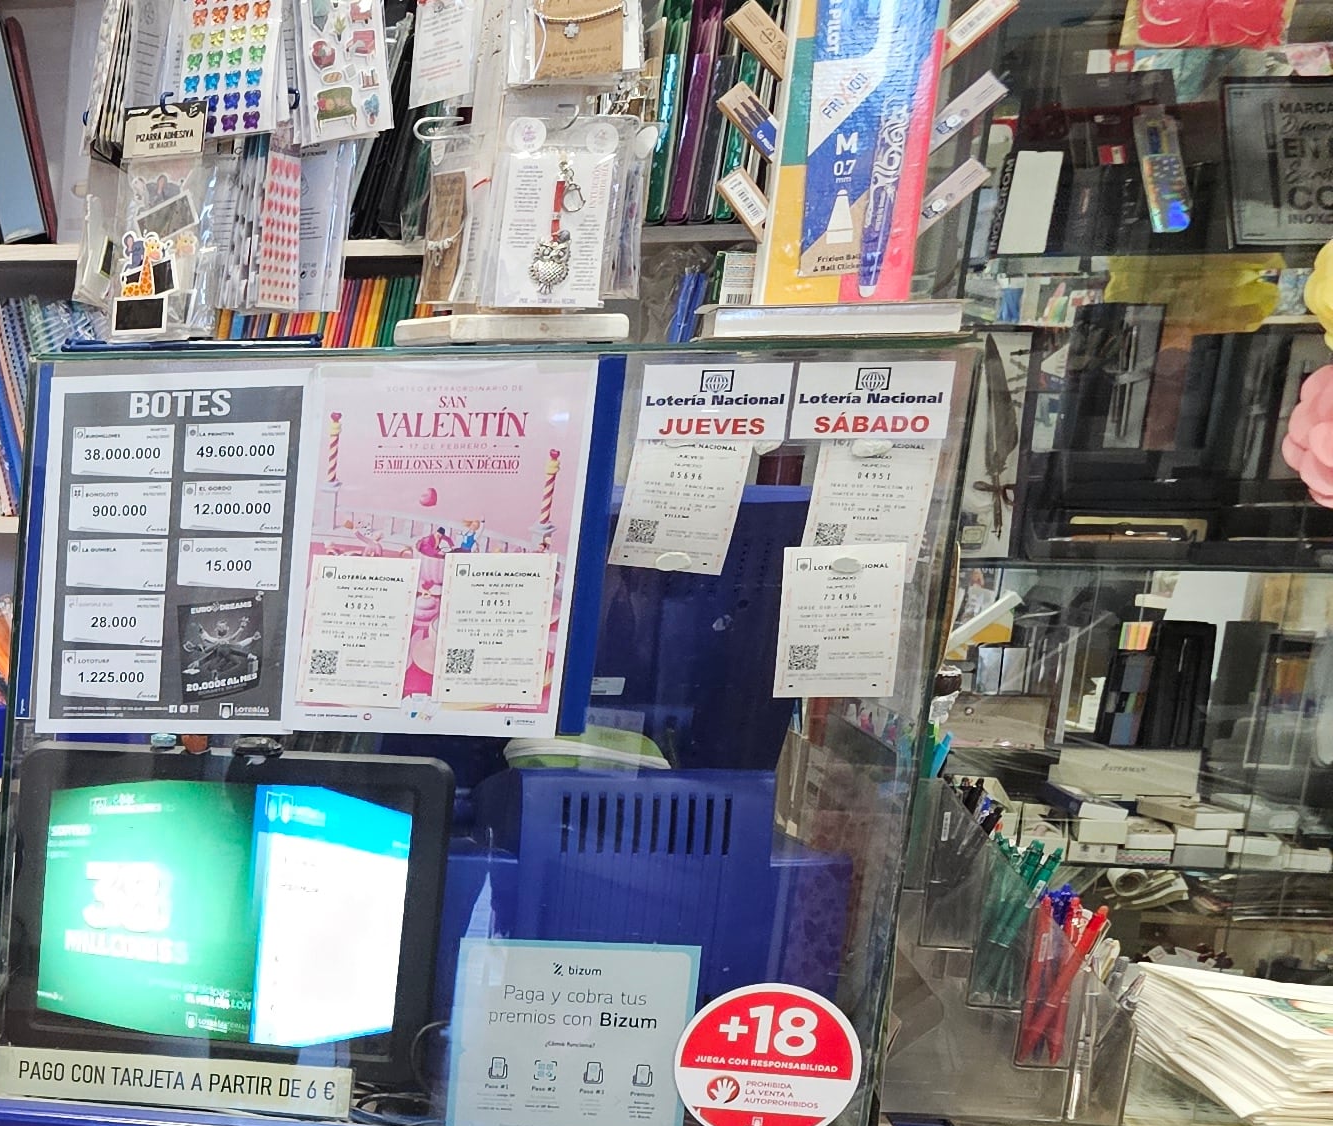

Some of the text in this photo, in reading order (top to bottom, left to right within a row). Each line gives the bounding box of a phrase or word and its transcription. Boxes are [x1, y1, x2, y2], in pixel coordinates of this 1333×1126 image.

[135, 129, 194, 143] PIZARRA ADHESIVA
[835, 132, 858, 156] M
[833, 159, 857, 176] 0.7
[988, 157, 1017, 252] INOXCROM
[129, 390, 232, 419] BOTES
[438, 395, 468, 410] SAN
[645, 393, 786, 407] Lotería Nacional
[799, 391, 943, 405] Lotería Nacional
[376, 406, 531, 438] VALENTÍN
[659, 417, 766, 436] JUEVES
[813, 412, 931, 434] SÁBADO
[84, 447, 161, 461] 38.000.000
[196, 444, 276, 459] 49.600.000
[374, 457, 520, 471] 15 MILLONES A UN DÉCIMO
[92, 504, 148, 518] 900.000
[194, 502, 272, 516] 12.000.000
[205, 559, 253, 573] 15.000
[90, 615, 138, 629] 28.000
[77, 671, 145, 684] 1.225.000
[568, 964, 603, 977] bizum
[503, 983, 647, 1006] Paga y cobra tus
[487, 1007, 658, 1030] premios con Bizum
[718, 1004, 819, 1058] +18
[695, 1055, 839, 1073] JUEGA CON RESPONSABILIDAD
[18, 1060, 336, 1101] PAGO CON TARJETA A PARTIR DE 6 €
[745, 1080, 792, 1090] PROHIBIDA
[759, 1090, 786, 1098] VENTA
[744, 1097, 819, 1109] AUTOPROHIBIDOS
